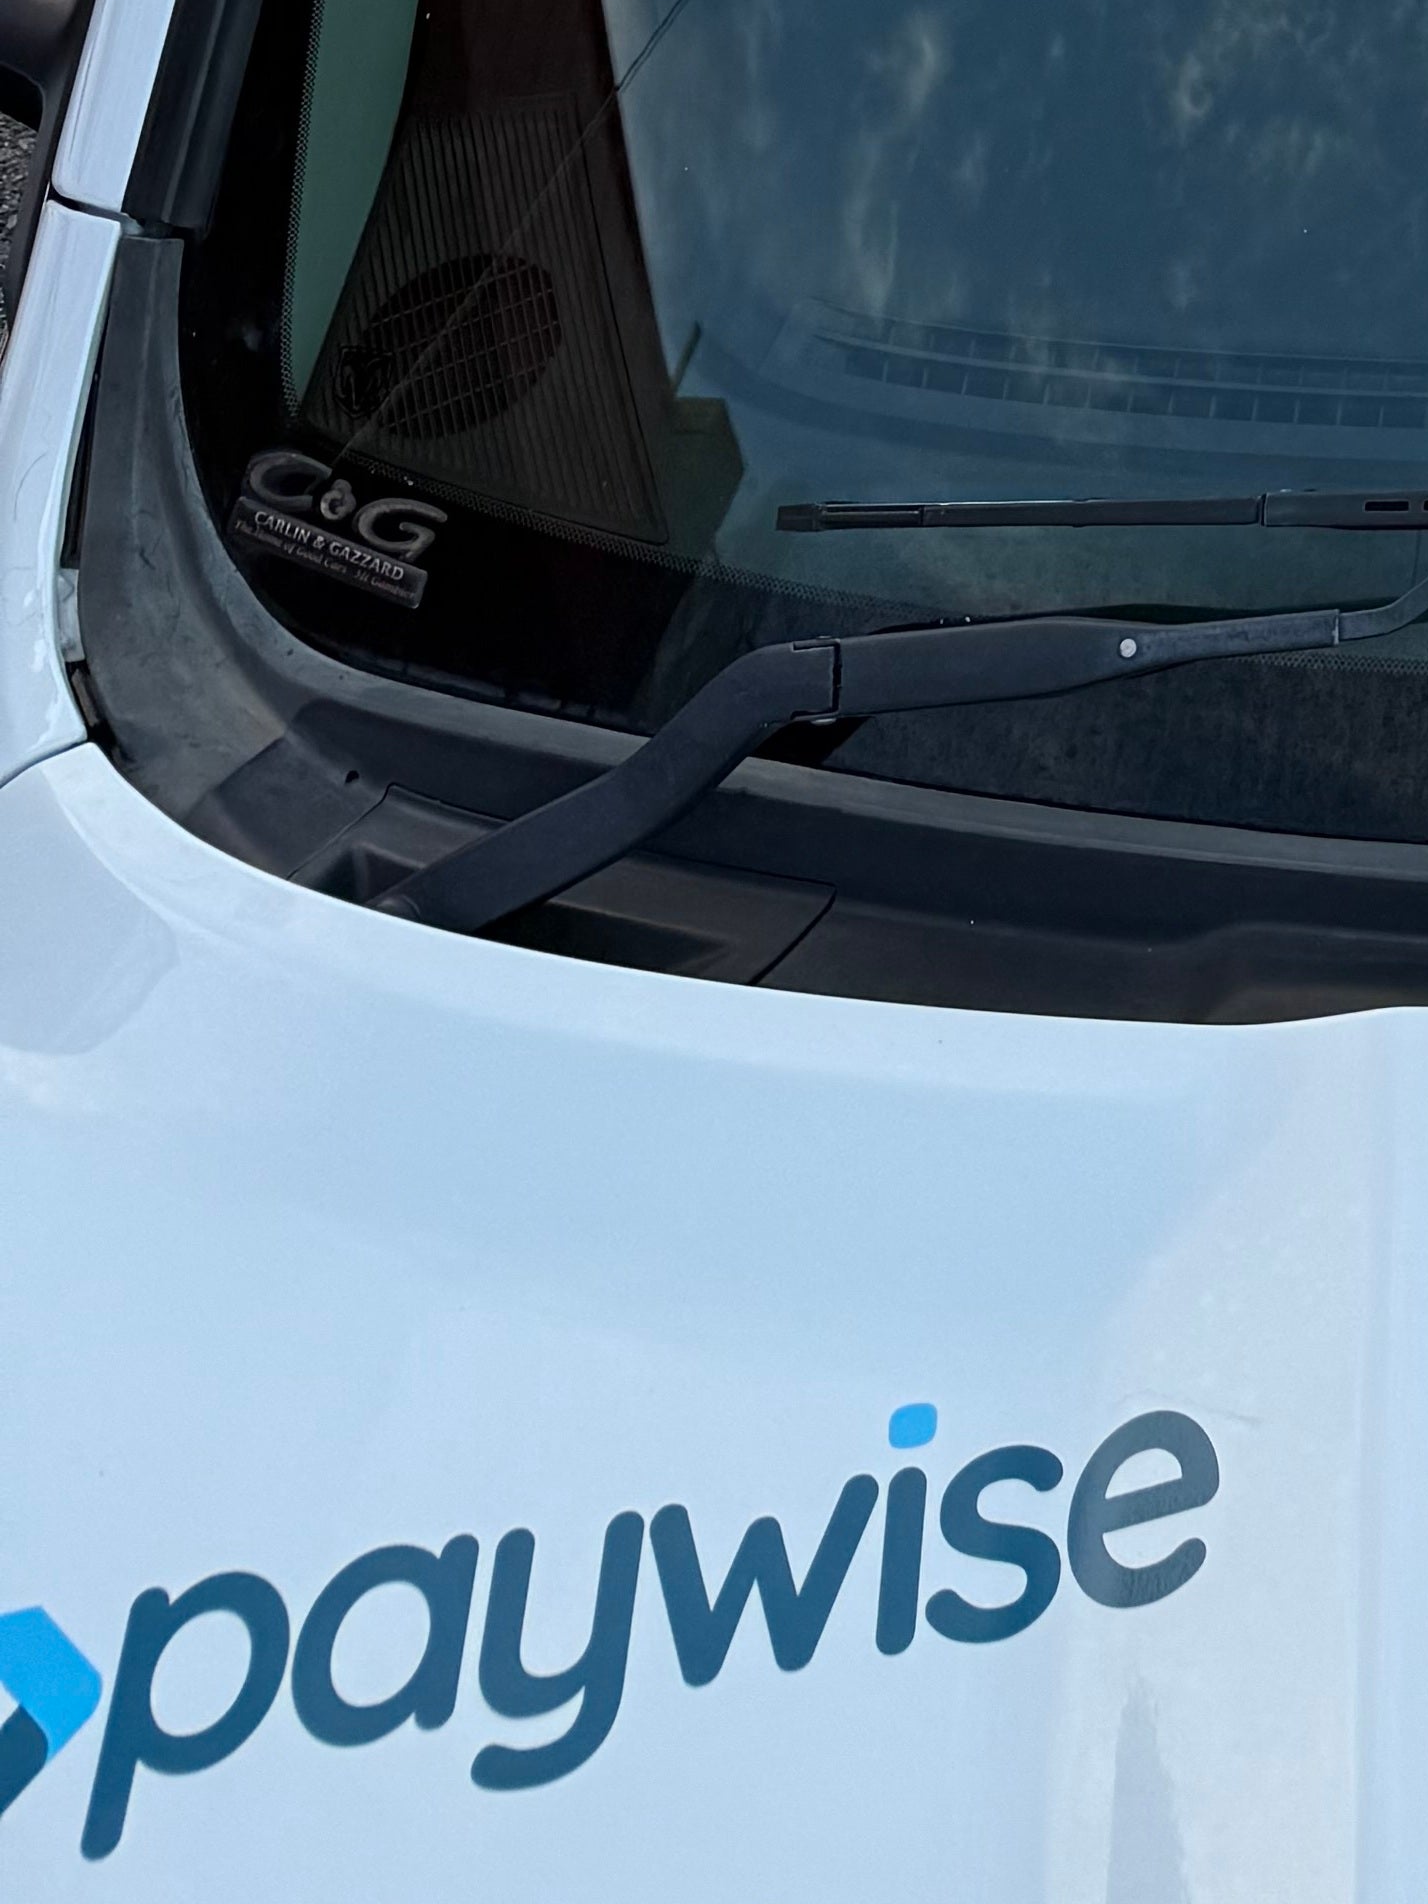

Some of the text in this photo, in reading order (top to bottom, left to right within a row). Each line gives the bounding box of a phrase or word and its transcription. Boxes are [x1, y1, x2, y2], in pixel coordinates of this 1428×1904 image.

[254, 510, 405, 581] CARLIN & GAZZARD
[80, 1403, 1219, 1861] paywise
